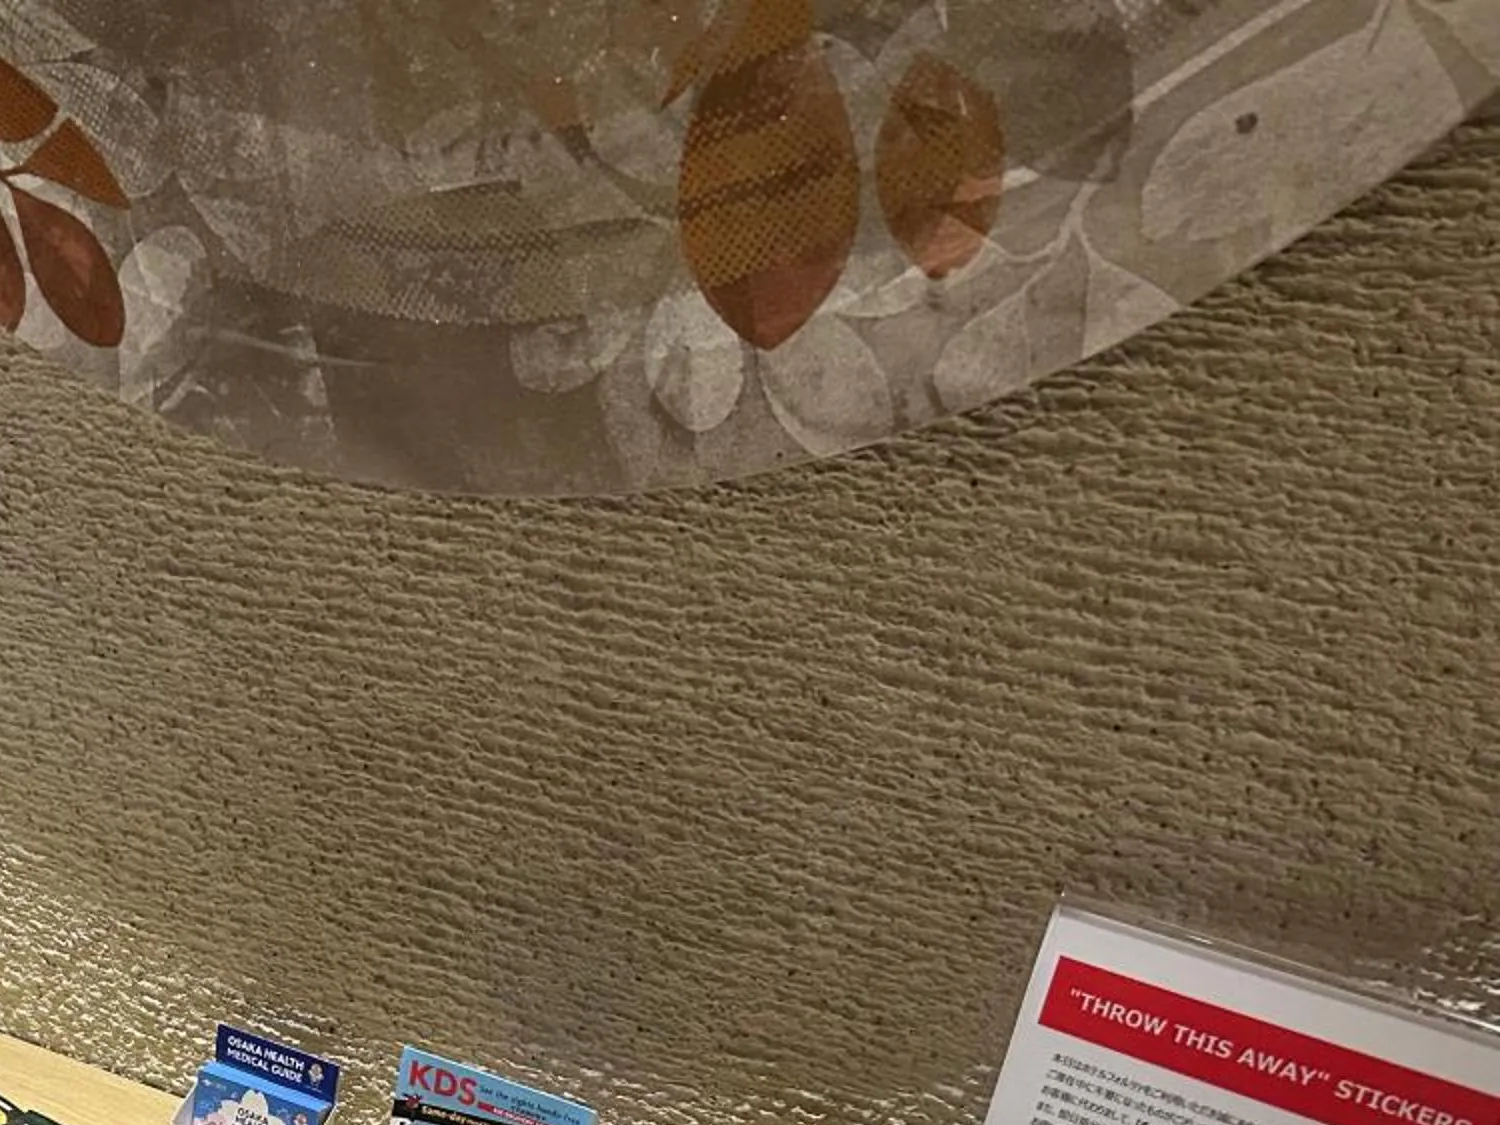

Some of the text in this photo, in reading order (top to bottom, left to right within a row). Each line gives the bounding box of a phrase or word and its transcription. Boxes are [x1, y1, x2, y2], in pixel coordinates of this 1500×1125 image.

[227, 1035, 305, 1071] OSAKA HEALTH
[1070, 988, 1168, 1035] "THROW
[1174, 1023, 1234, 1059] THIS
[1236, 1047, 1330, 1086] AWAY"
[227, 1047, 303, 1083] MEDICAL GUIDE
[408, 1059, 479, 1107] KDS
[238, 1107, 269, 1125] OSAKA
